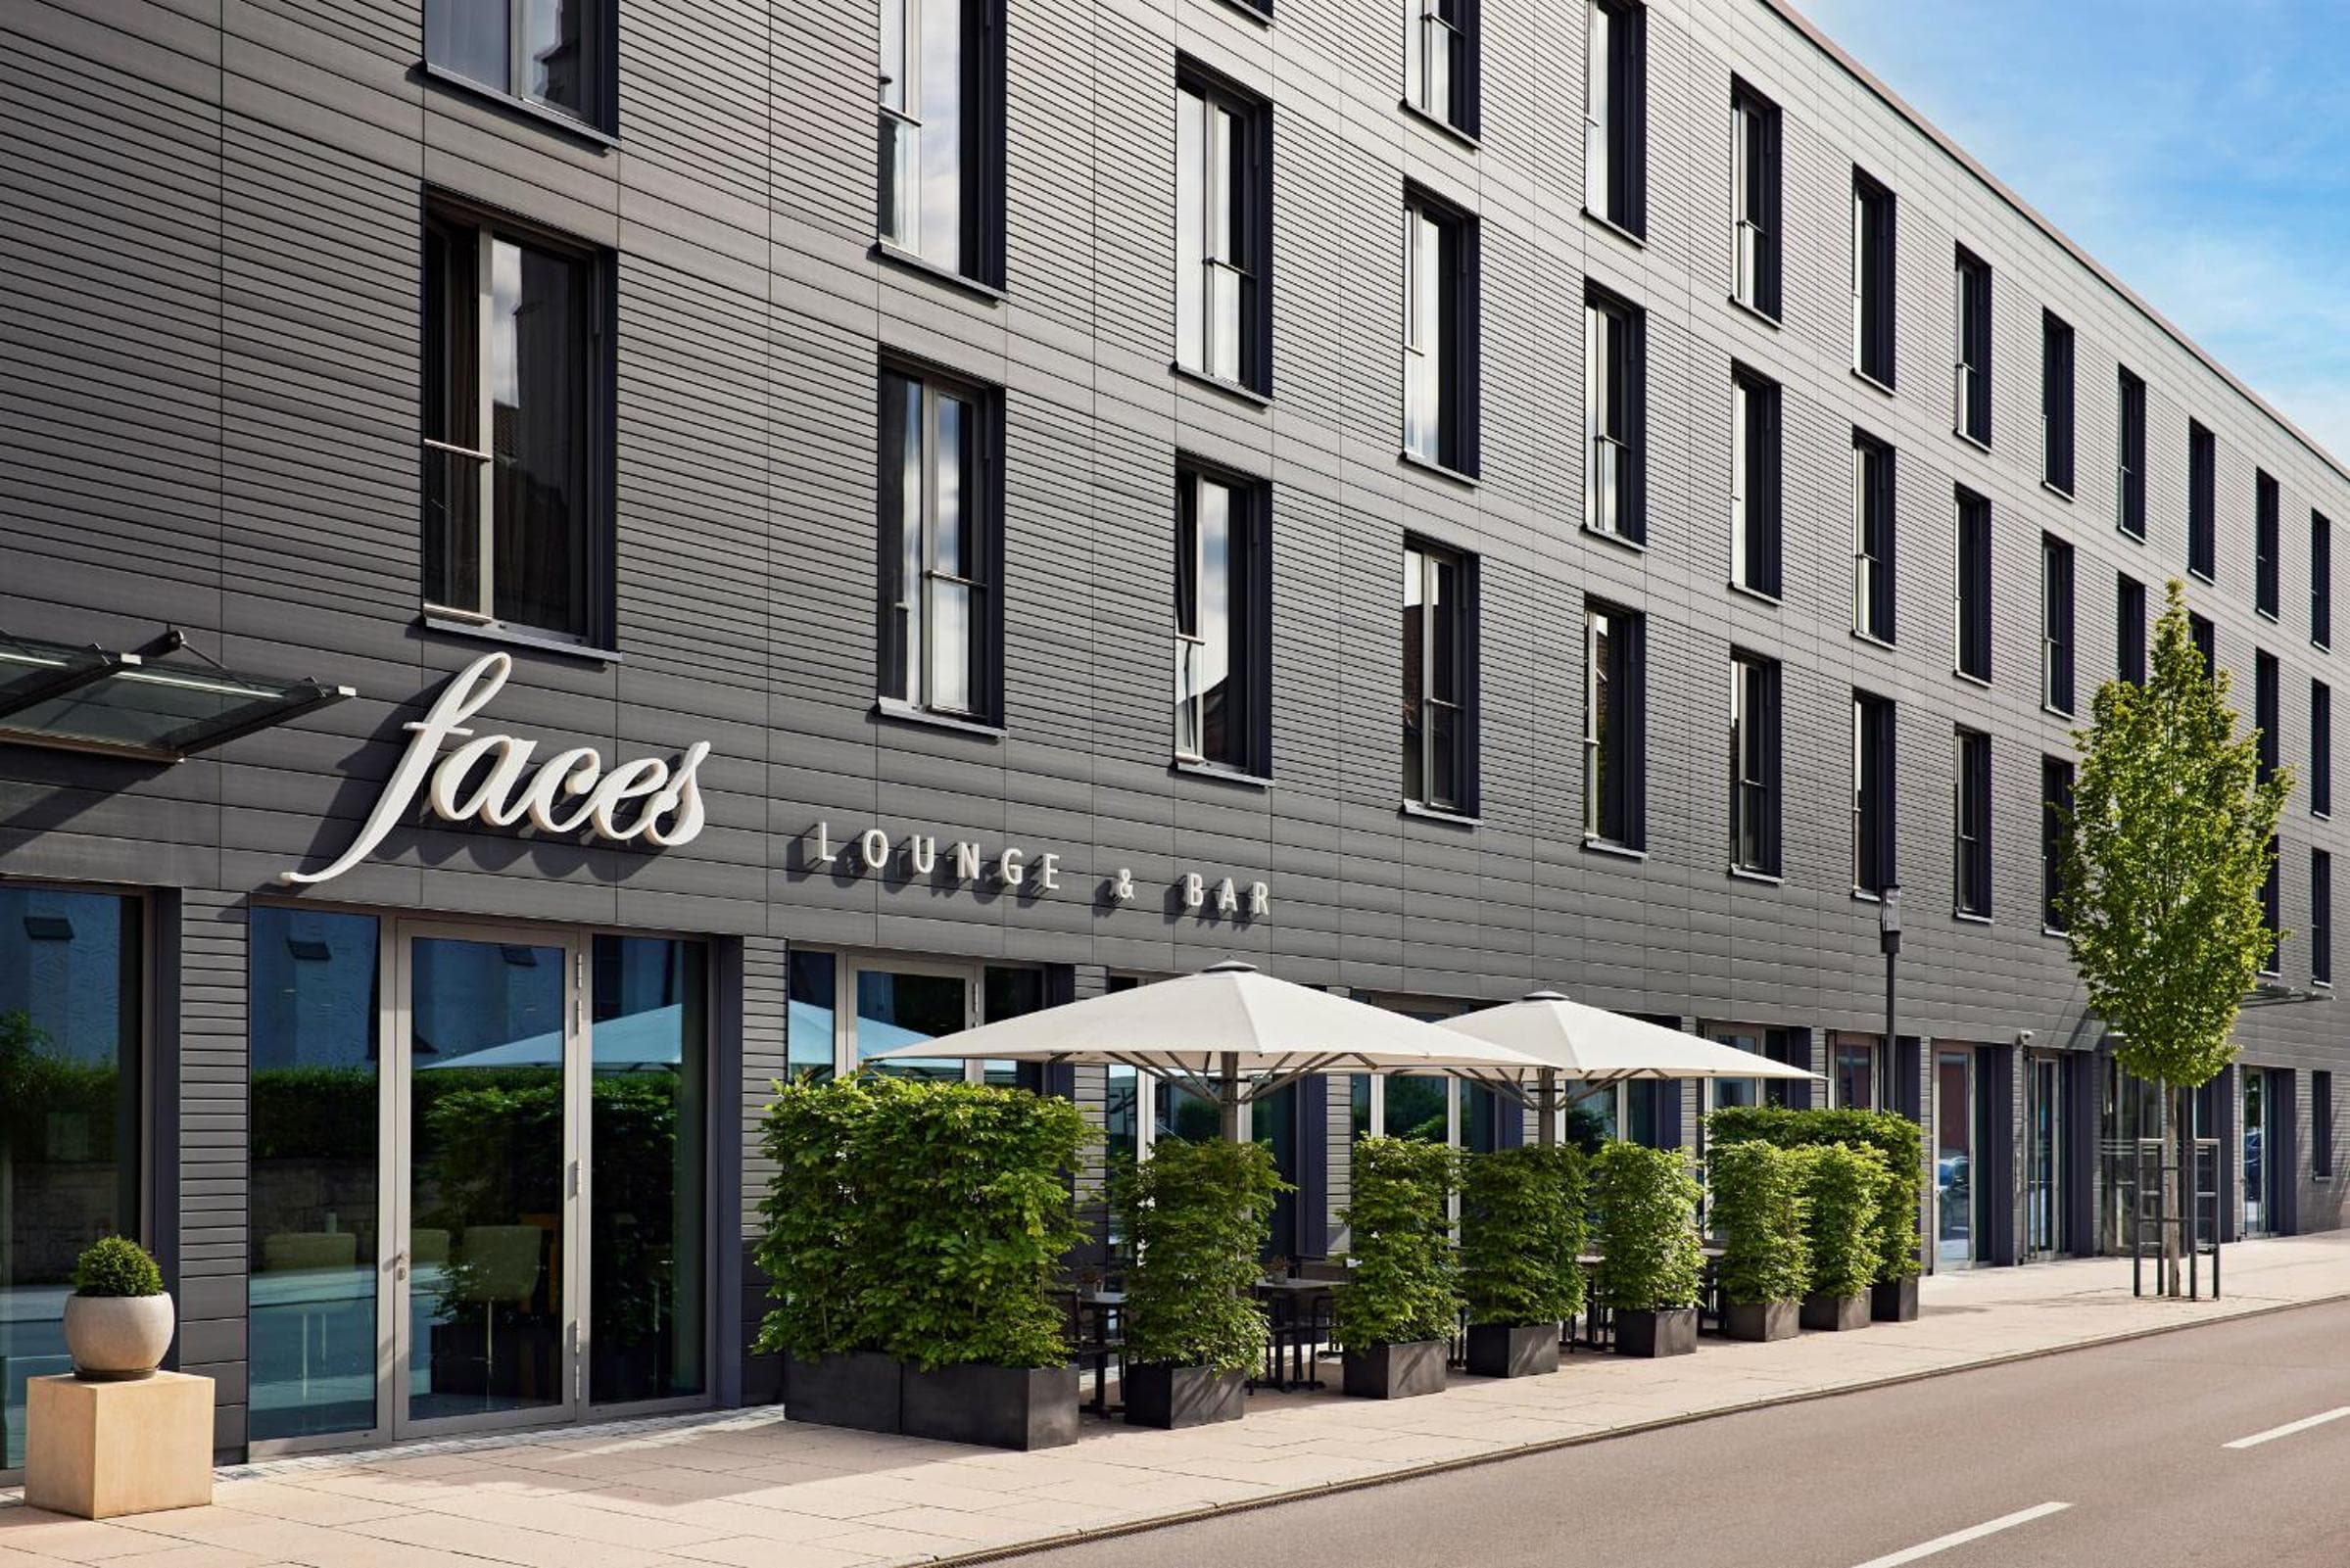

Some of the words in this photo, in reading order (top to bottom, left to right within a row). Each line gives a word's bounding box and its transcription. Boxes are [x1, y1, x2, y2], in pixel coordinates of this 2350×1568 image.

[280, 651, 711, 882] faces
[817, 821, 1061, 889] LOUNGE
[1116, 868, 1135, 900] &
[1186, 872, 1270, 916] BAR
